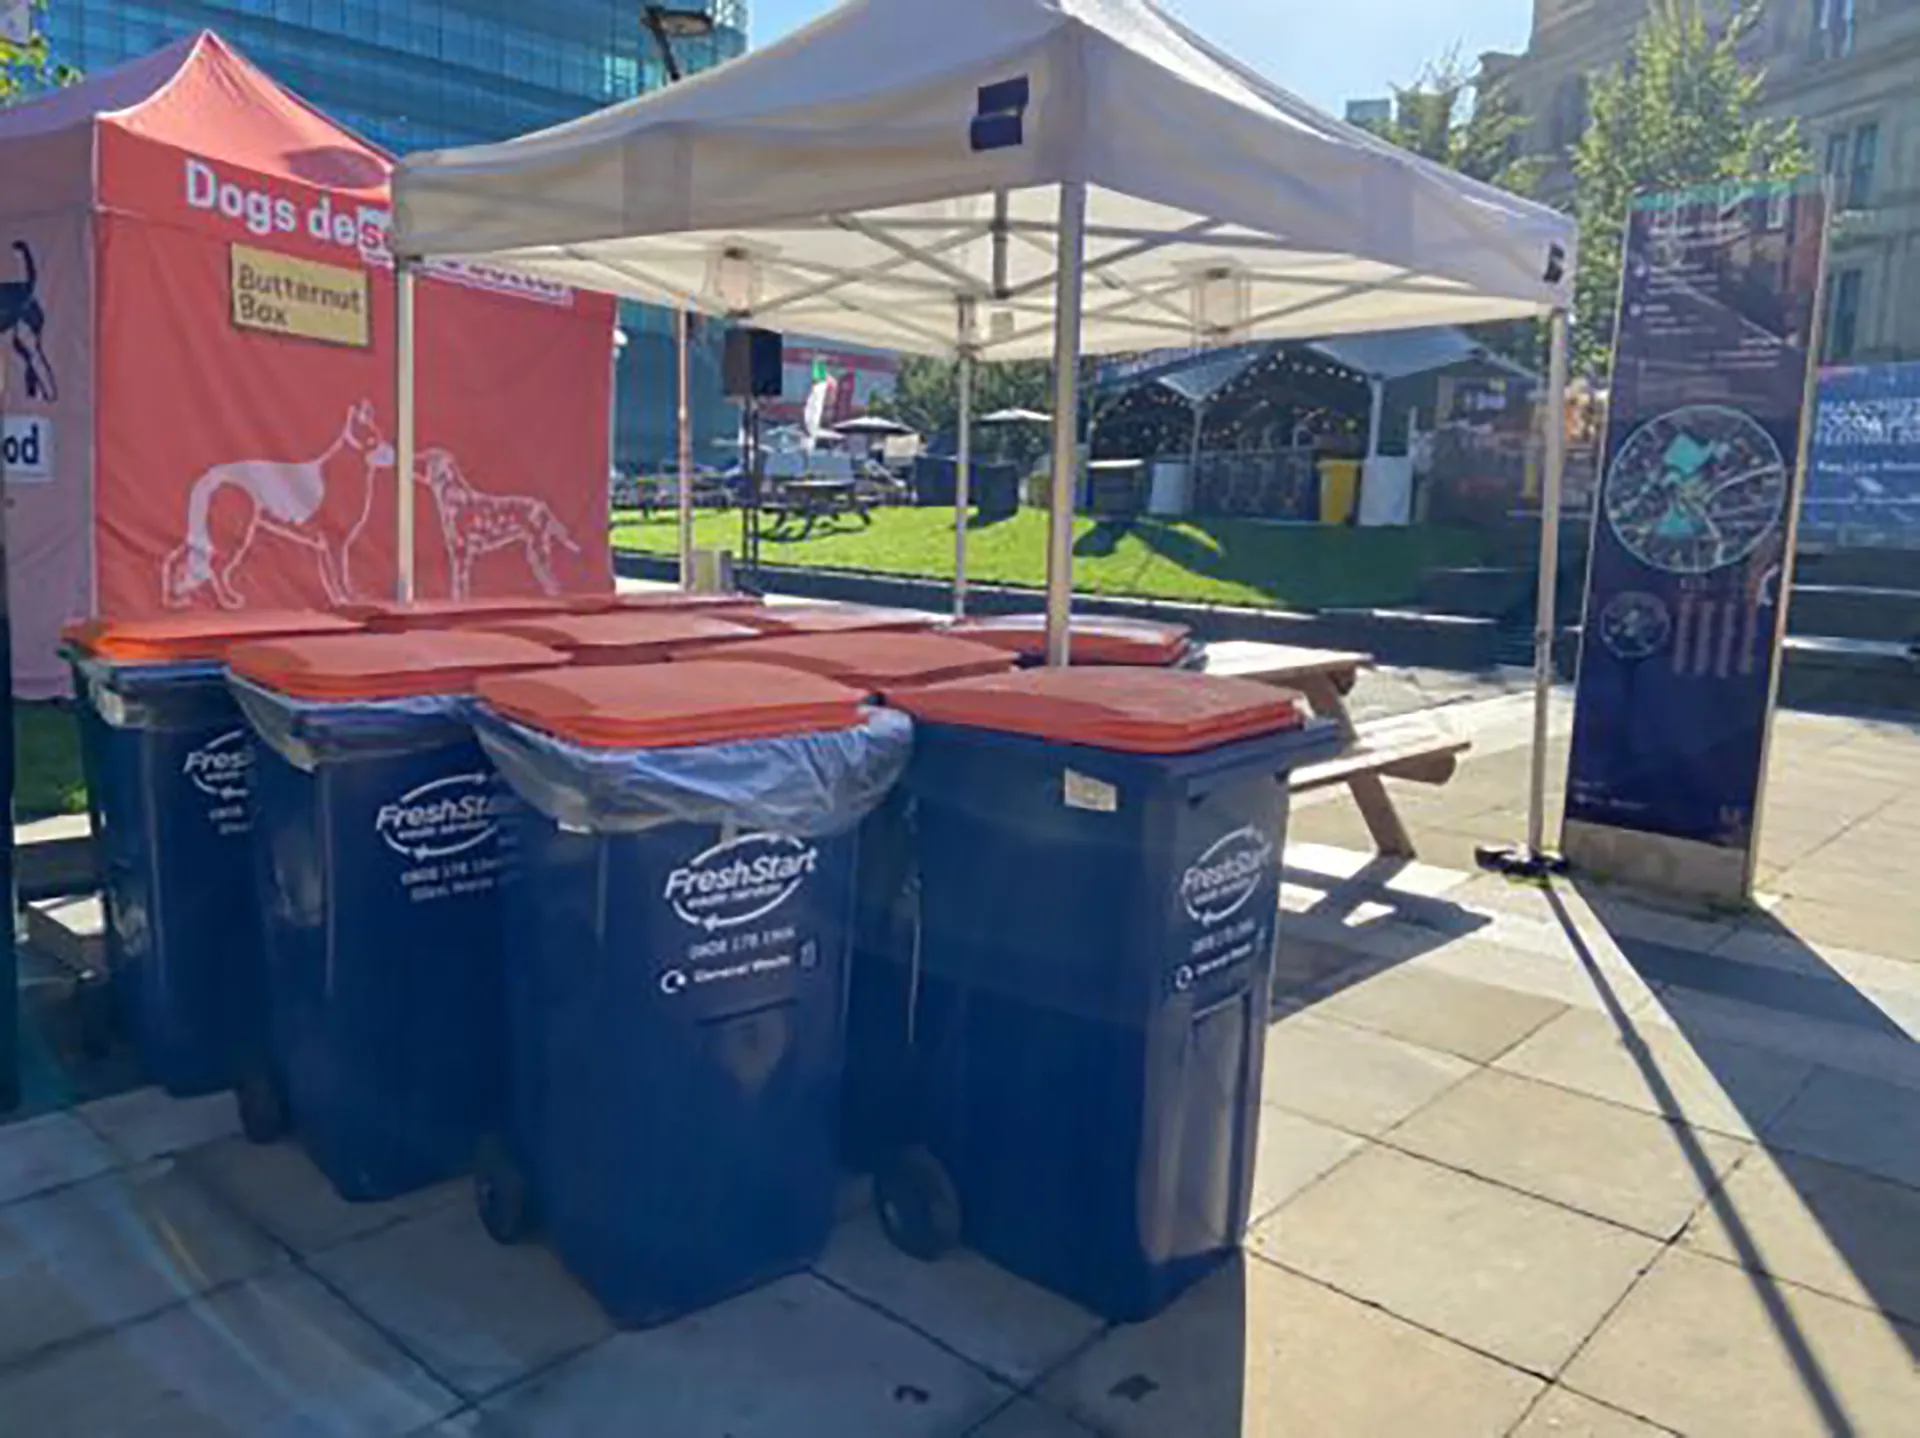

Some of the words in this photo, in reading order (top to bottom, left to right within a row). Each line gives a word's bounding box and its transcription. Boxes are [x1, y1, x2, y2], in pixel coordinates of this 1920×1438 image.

[186, 159, 297, 235] Dogs
[307, 197, 390, 250] des
[239, 263, 361, 314] Butternut
[3, 422, 39, 465] od
[183, 751, 250, 773] Fres
[376, 796, 488, 830] FreshSt
[664, 848, 818, 898] FreshStart
